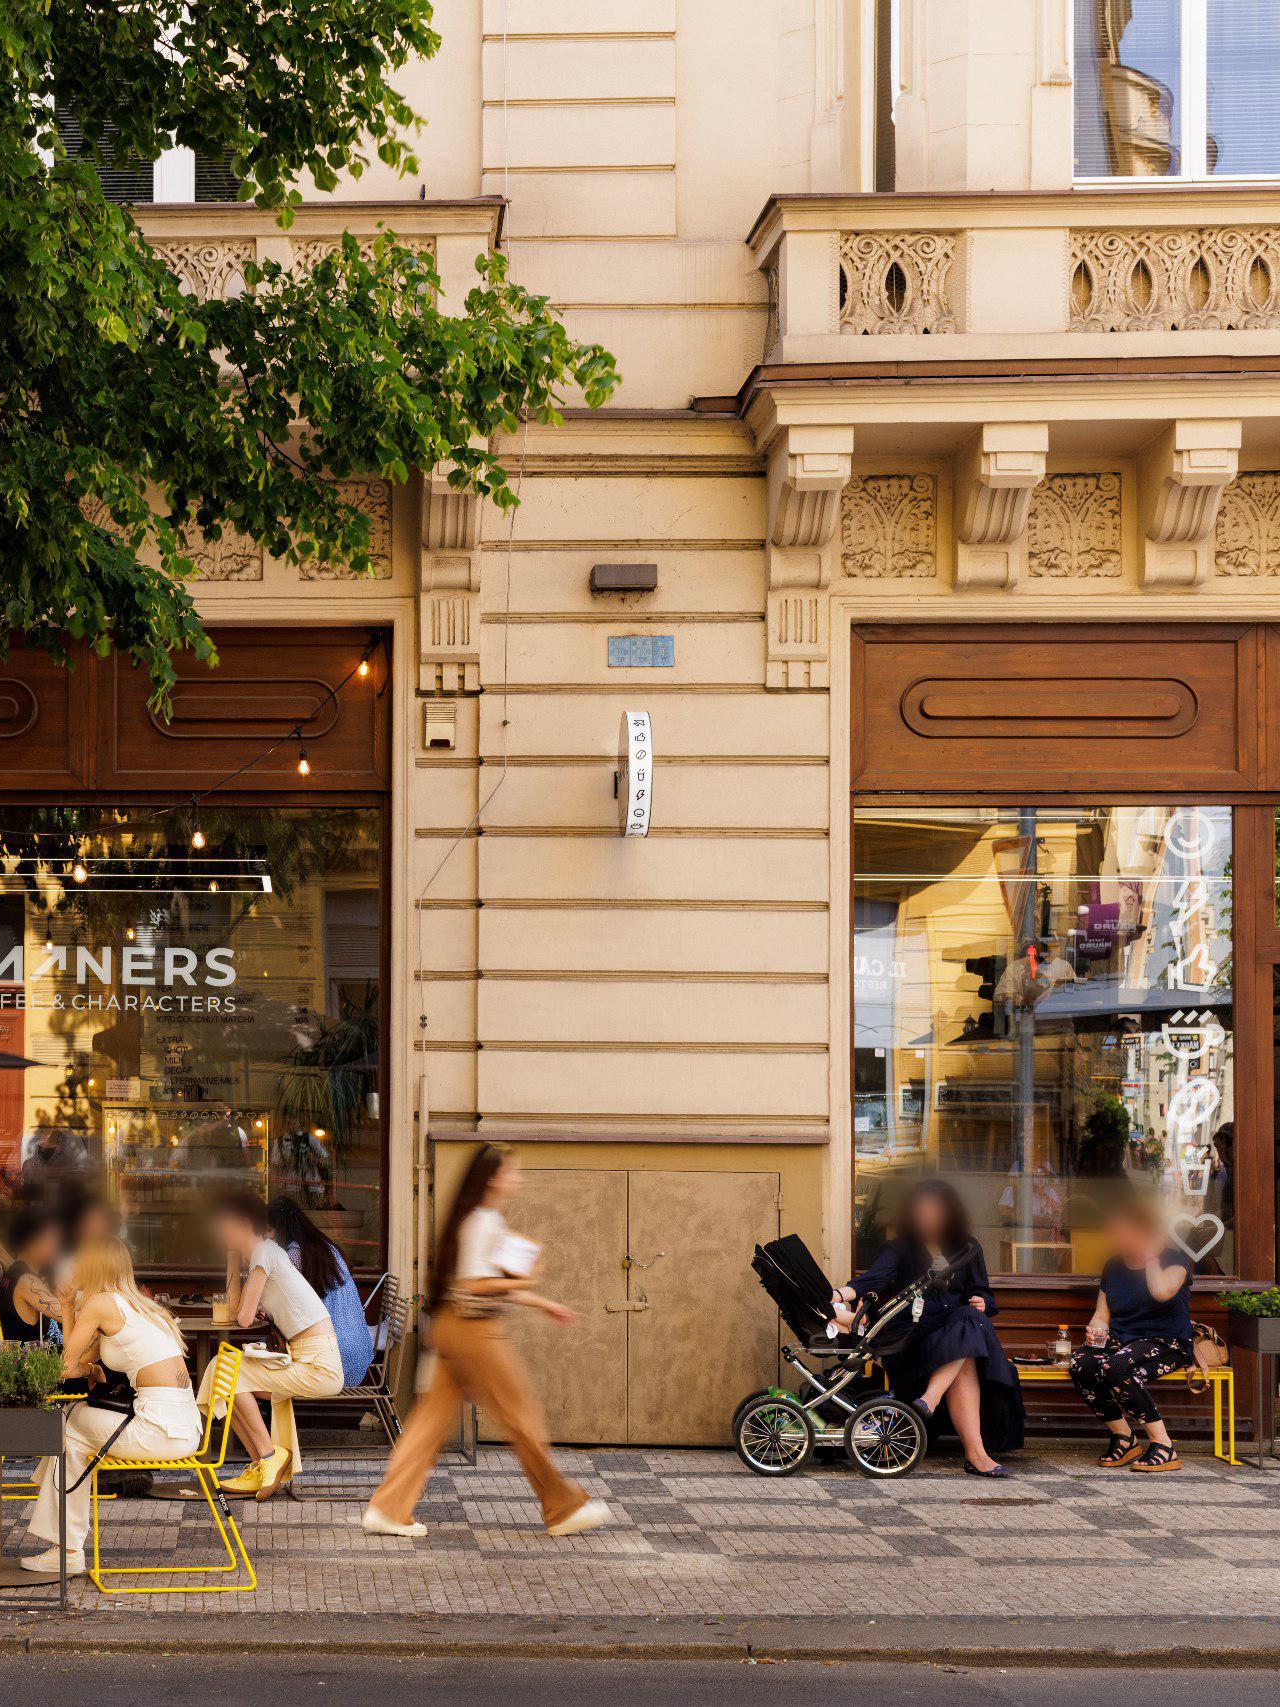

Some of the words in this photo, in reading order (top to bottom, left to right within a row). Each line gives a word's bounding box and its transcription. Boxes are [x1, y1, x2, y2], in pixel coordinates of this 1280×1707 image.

[52, 993, 66, 1010] &
[71, 994, 237, 1012] CHARACTERS
[176, 1016, 220, 1024] COCONUT
[220, 1016, 255, 1024] MATCHA
[156, 1036, 184, 1044] EXTRA
[164, 1046, 187, 1054] SHOT
[164, 1056, 184, 1064] MILK
[164, 1067, 193, 1075] DECAF
